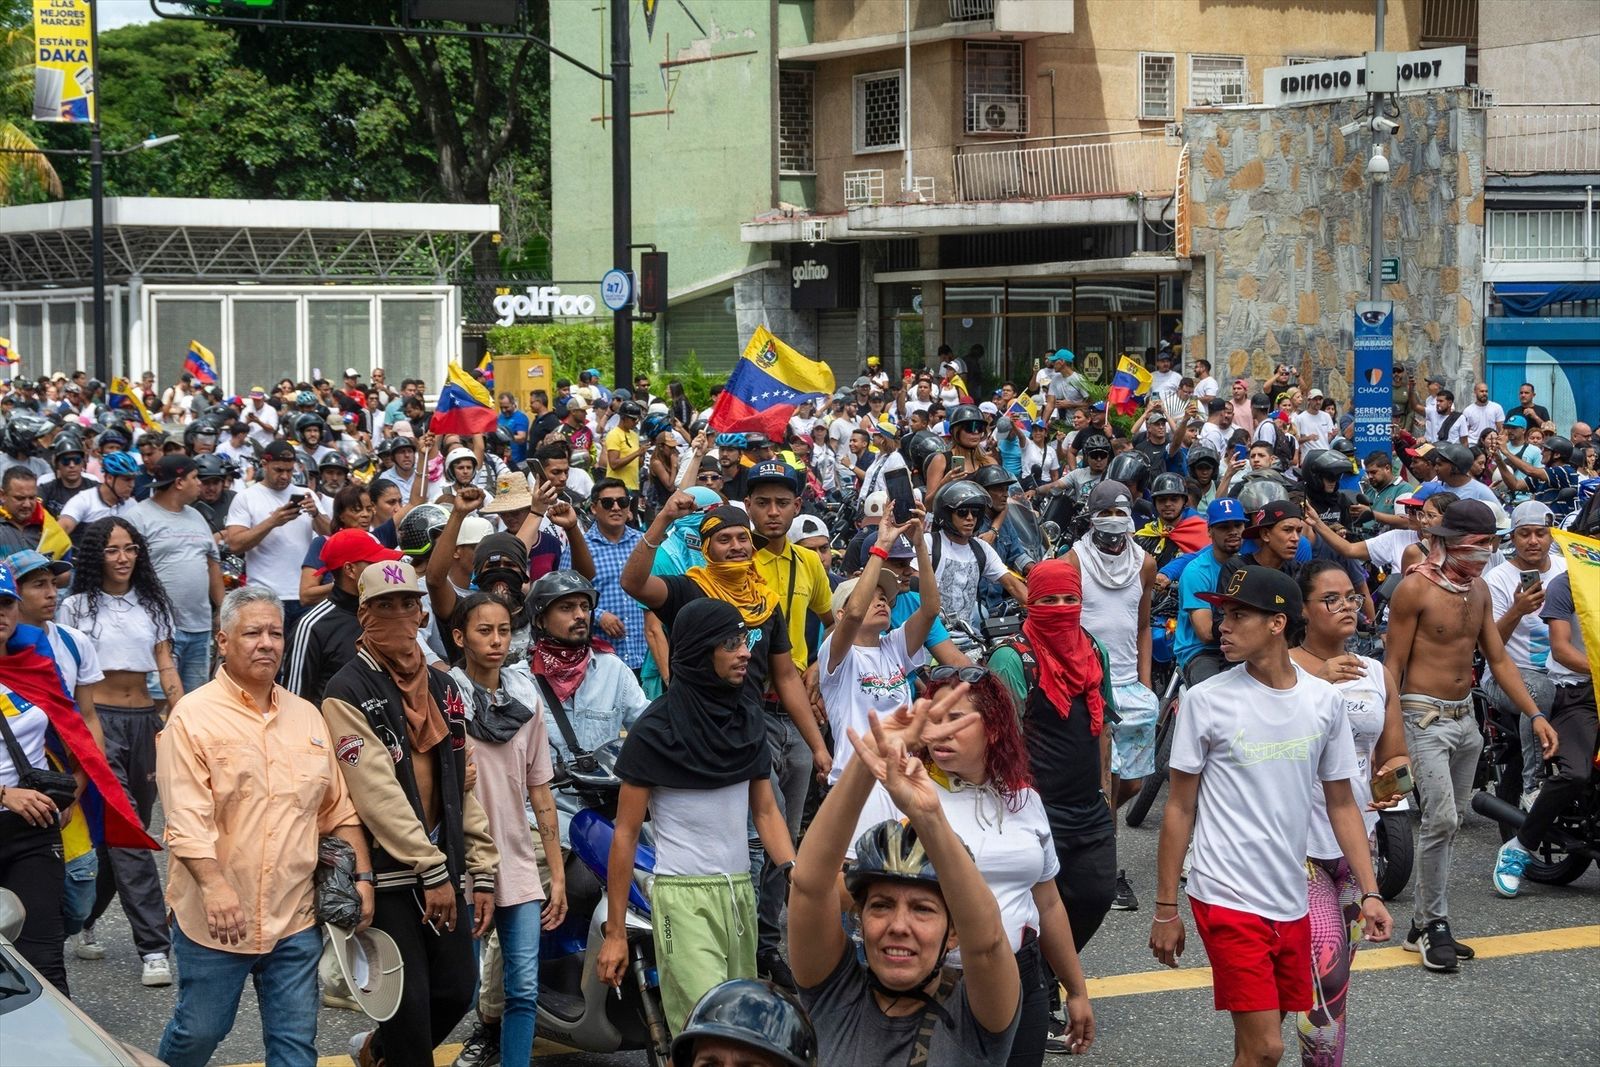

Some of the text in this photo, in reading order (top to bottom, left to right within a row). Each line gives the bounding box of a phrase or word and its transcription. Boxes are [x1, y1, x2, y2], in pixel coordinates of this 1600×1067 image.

[40, 37, 72, 46] ESTÁN
[40, 49, 88, 62] DAKA
[1280, 70, 1351, 93] EDIFICIO
[493, 286, 596, 327] golfiao
[1088, 356, 1098, 368] NO
[1366, 423, 1392, 436] 365
[1219, 499, 1233, 514] T
[382, 564, 406, 585] NY
[1226, 569, 1248, 596] C
[1245, 742, 1308, 760] NIKE
[663, 914, 672, 939] adidas
